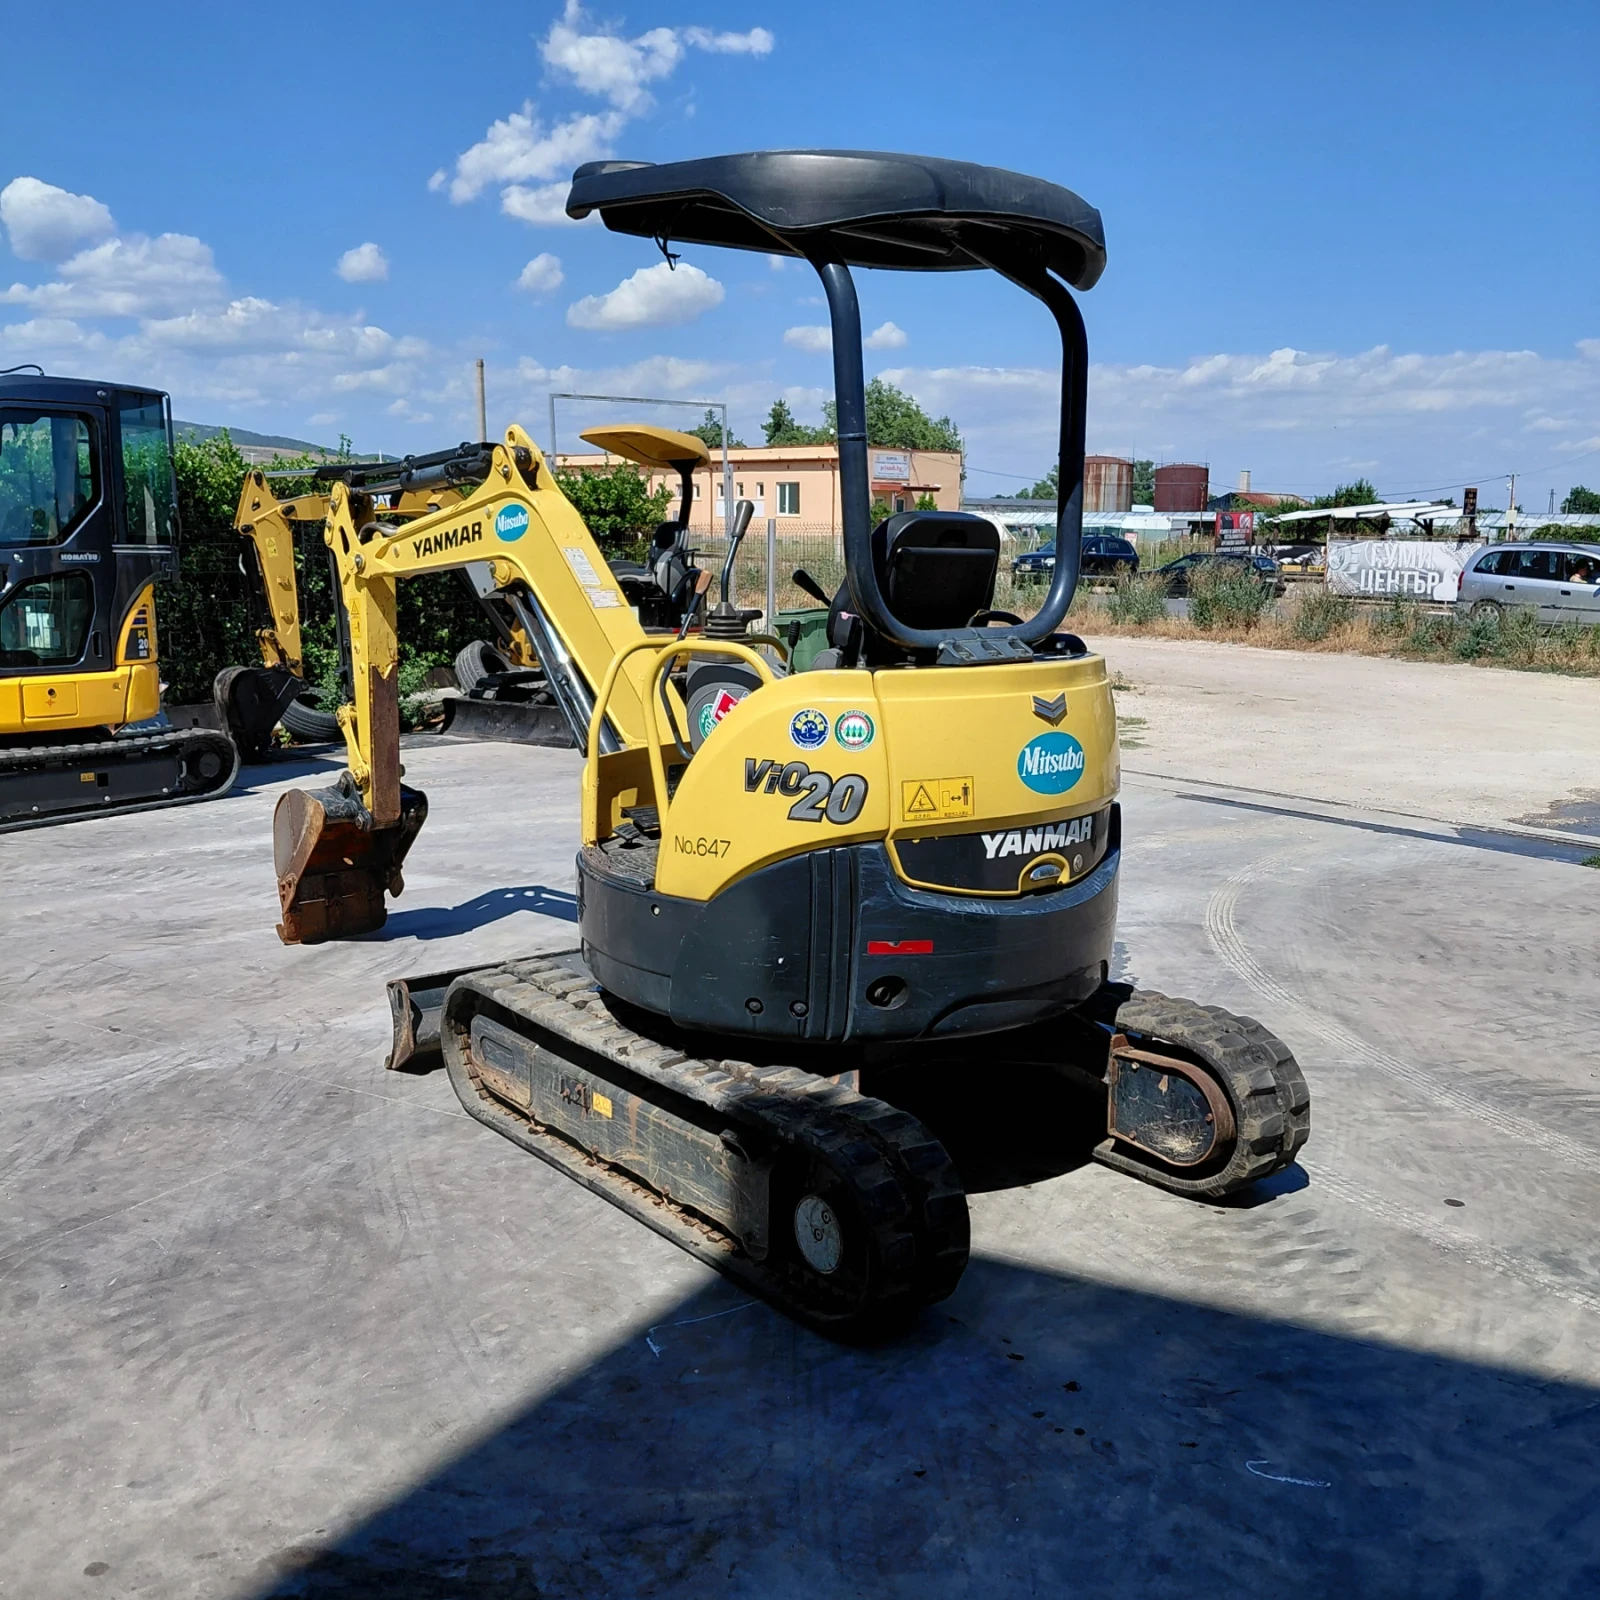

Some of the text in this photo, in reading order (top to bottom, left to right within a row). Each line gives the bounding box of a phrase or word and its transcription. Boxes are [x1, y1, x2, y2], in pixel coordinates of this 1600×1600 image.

[413, 521, 482, 559] YANMAR
[1370, 541, 1433, 570] ГУМИ
[1360, 569, 1440, 594] ЦЕНТЪР
[138, 639, 149, 649] 20
[1021, 746, 1083, 777] Mitsuba
[674, 834, 732, 859] No.647
[981, 815, 1092, 859] YANMAR
